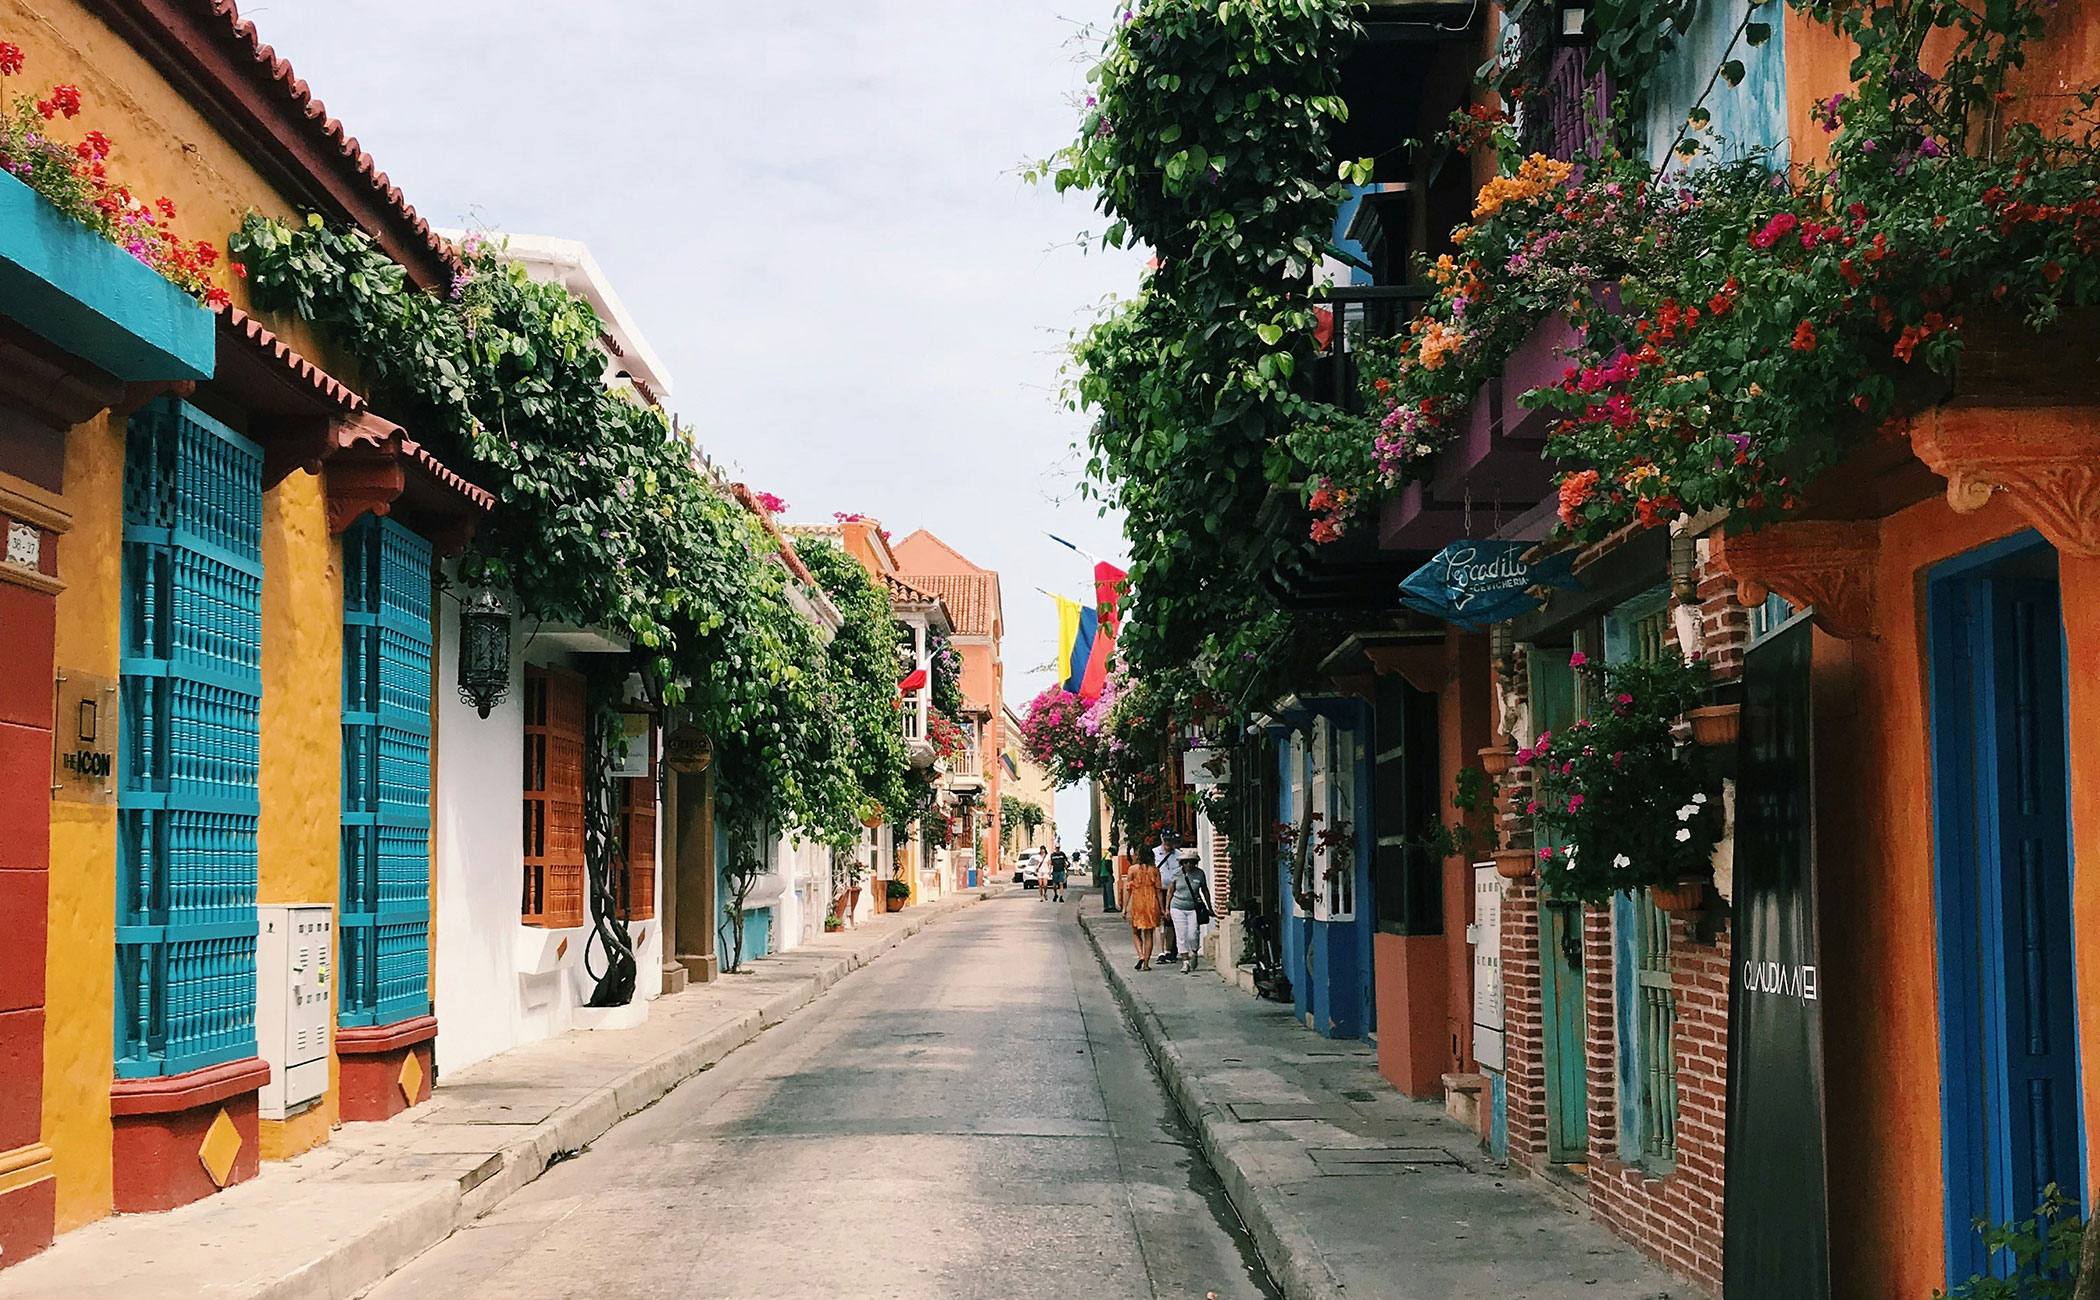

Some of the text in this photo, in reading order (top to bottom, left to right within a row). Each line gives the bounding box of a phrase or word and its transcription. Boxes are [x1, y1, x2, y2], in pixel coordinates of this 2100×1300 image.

[1445, 545, 1527, 587] Pescadito
[63, 750, 110, 776] THE ICON
[1744, 960, 1790, 995] CLAUDIA
